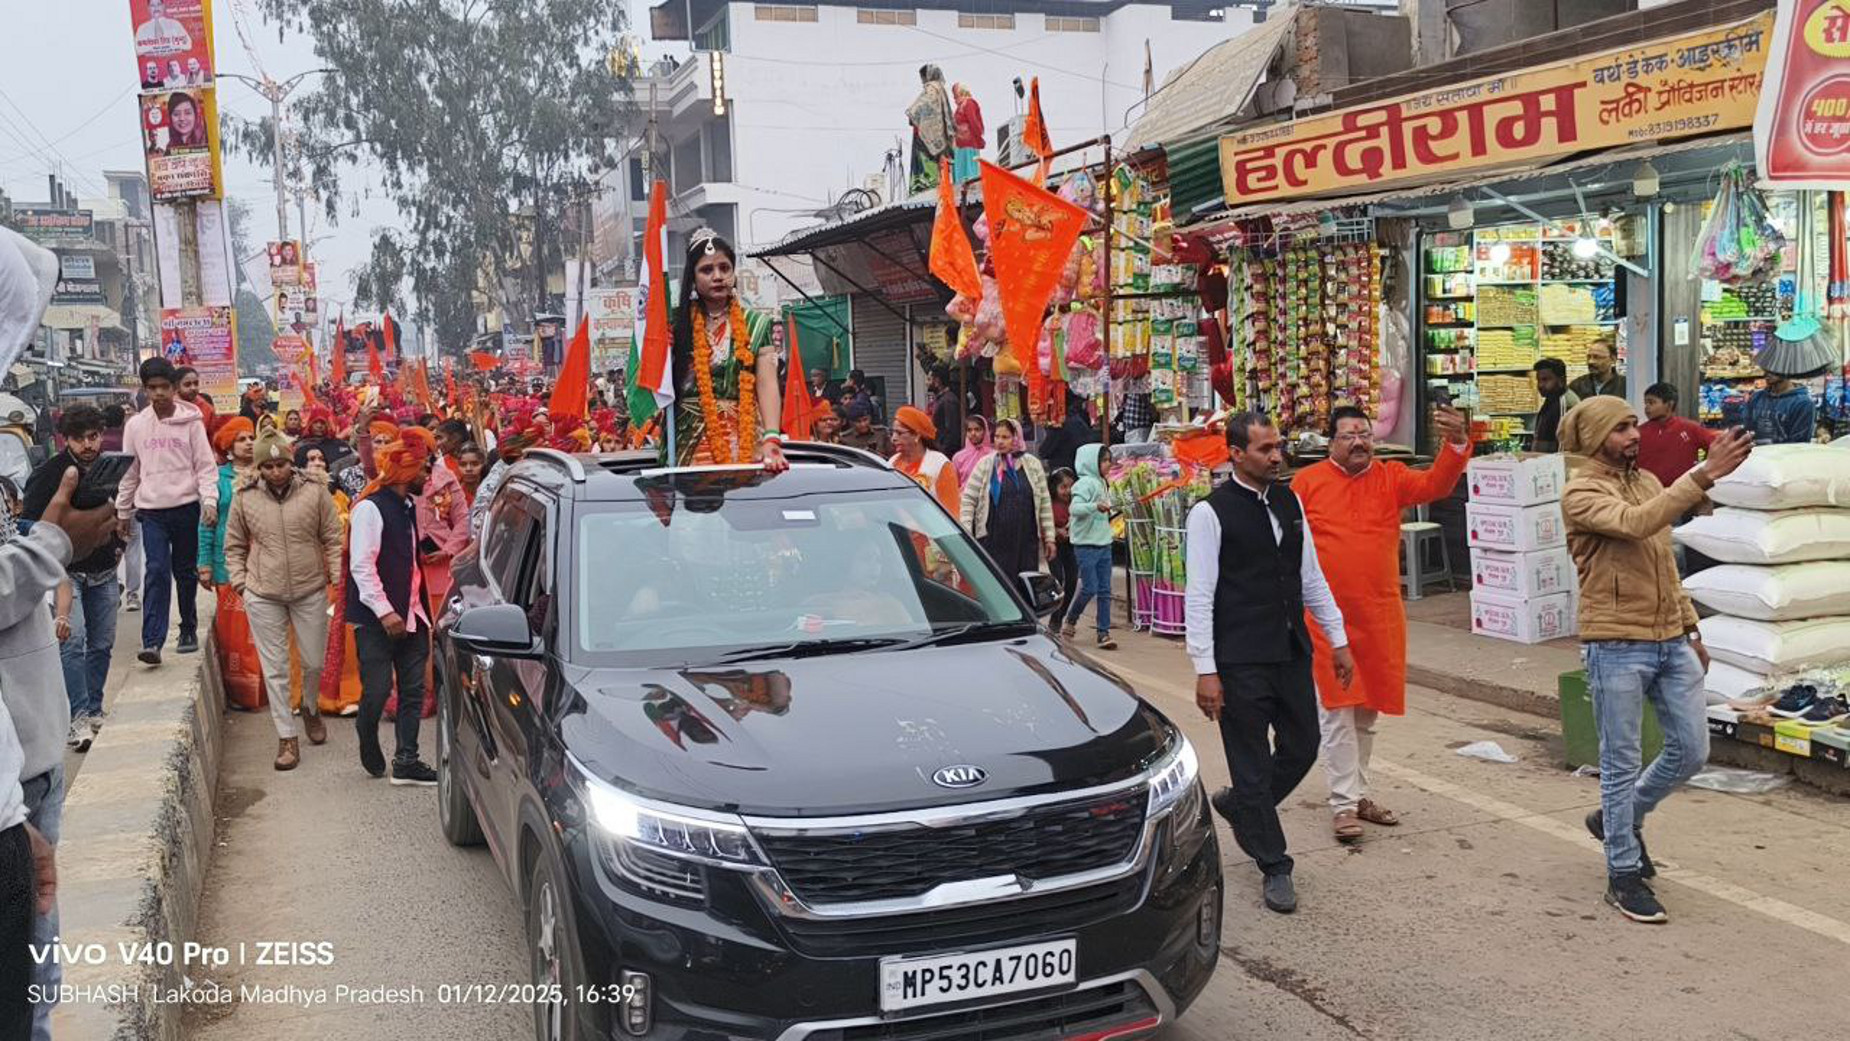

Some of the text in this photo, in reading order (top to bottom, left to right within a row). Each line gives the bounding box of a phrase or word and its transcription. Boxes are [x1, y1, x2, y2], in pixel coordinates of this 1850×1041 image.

[1599, 81, 1651, 125] लकी
[1234, 79, 1588, 197] हल्दीराम
[942, 768, 982, 783] KIA
[902, 948, 1072, 1000] MP53CA7060
